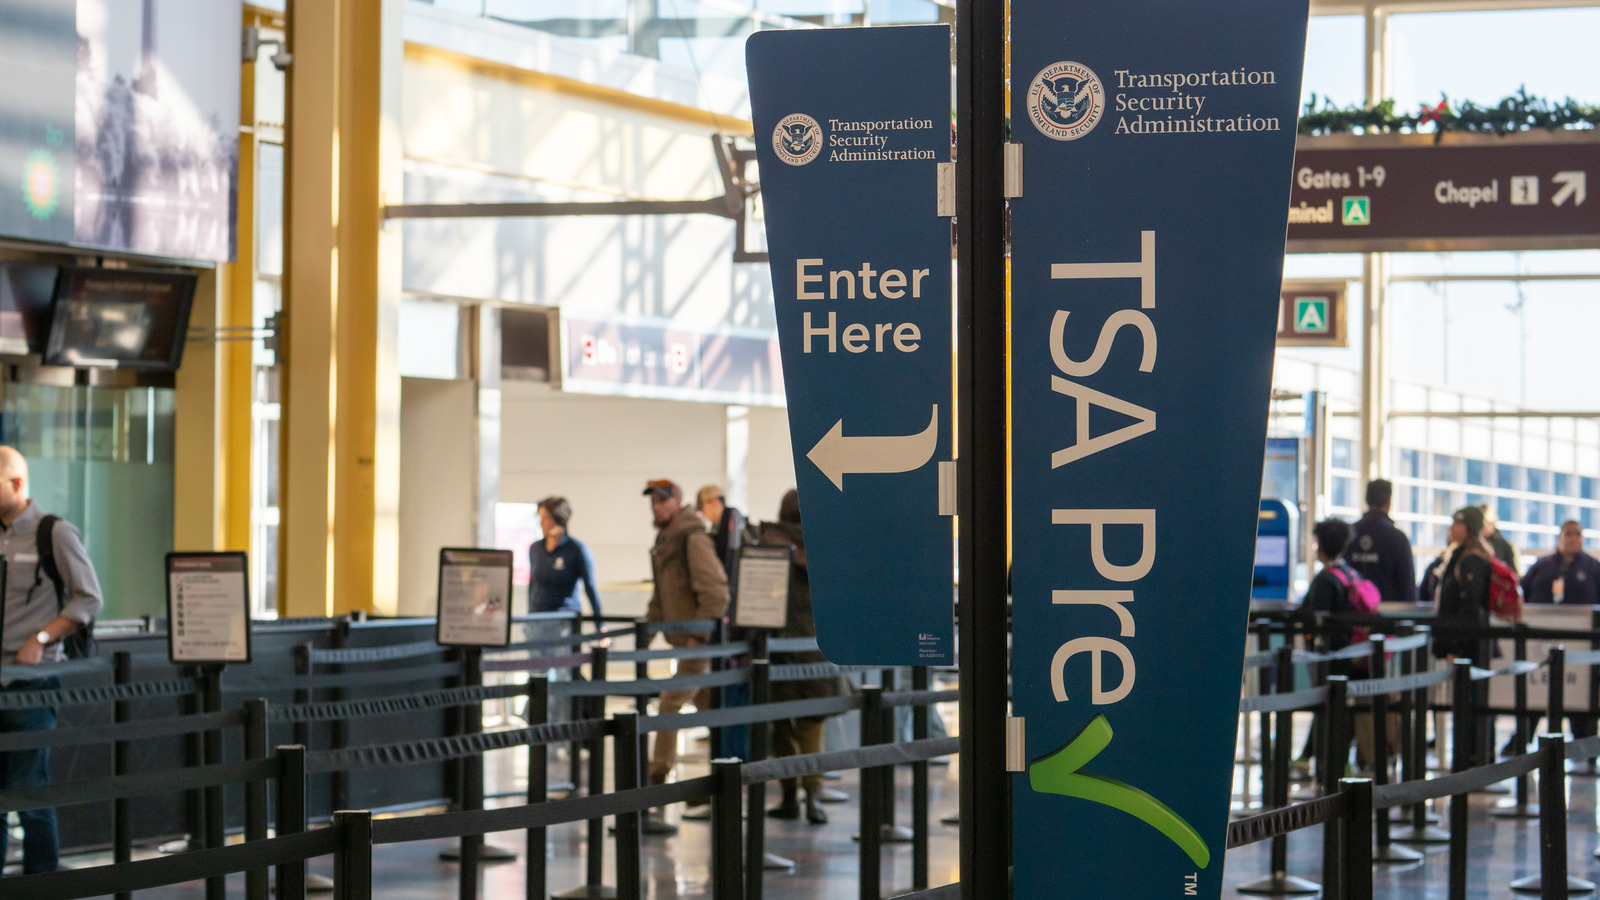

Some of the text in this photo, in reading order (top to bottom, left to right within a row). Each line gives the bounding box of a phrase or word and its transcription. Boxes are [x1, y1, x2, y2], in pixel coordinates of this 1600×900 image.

[1042, 65, 1096, 84] DEPARTMENT
[1092, 83, 1101, 95] OF
[1114, 67, 1277, 92] Transportation
[1115, 92, 1206, 115] Security
[782, 116, 817, 128] DEPARTMENT
[828, 117, 933, 134] Transportation
[1031, 104, 1101, 137] HOMELAND SECURITY
[1114, 114, 1281, 135] Administration
[775, 141, 820, 164] HOMELAND SECURITY
[829, 134, 888, 149] Security
[829, 148, 936, 162] Administration
[1297, 165, 1386, 190] Gates 1-9
[1435, 178, 1499, 208] Chapel
[1288, 199, 1366, 224] minal A
[796, 258, 930, 300] Enter
[1299, 301, 1323, 329] A
[803, 311, 921, 353] Here
[1050, 230, 1197, 896] TSA Pre TM
